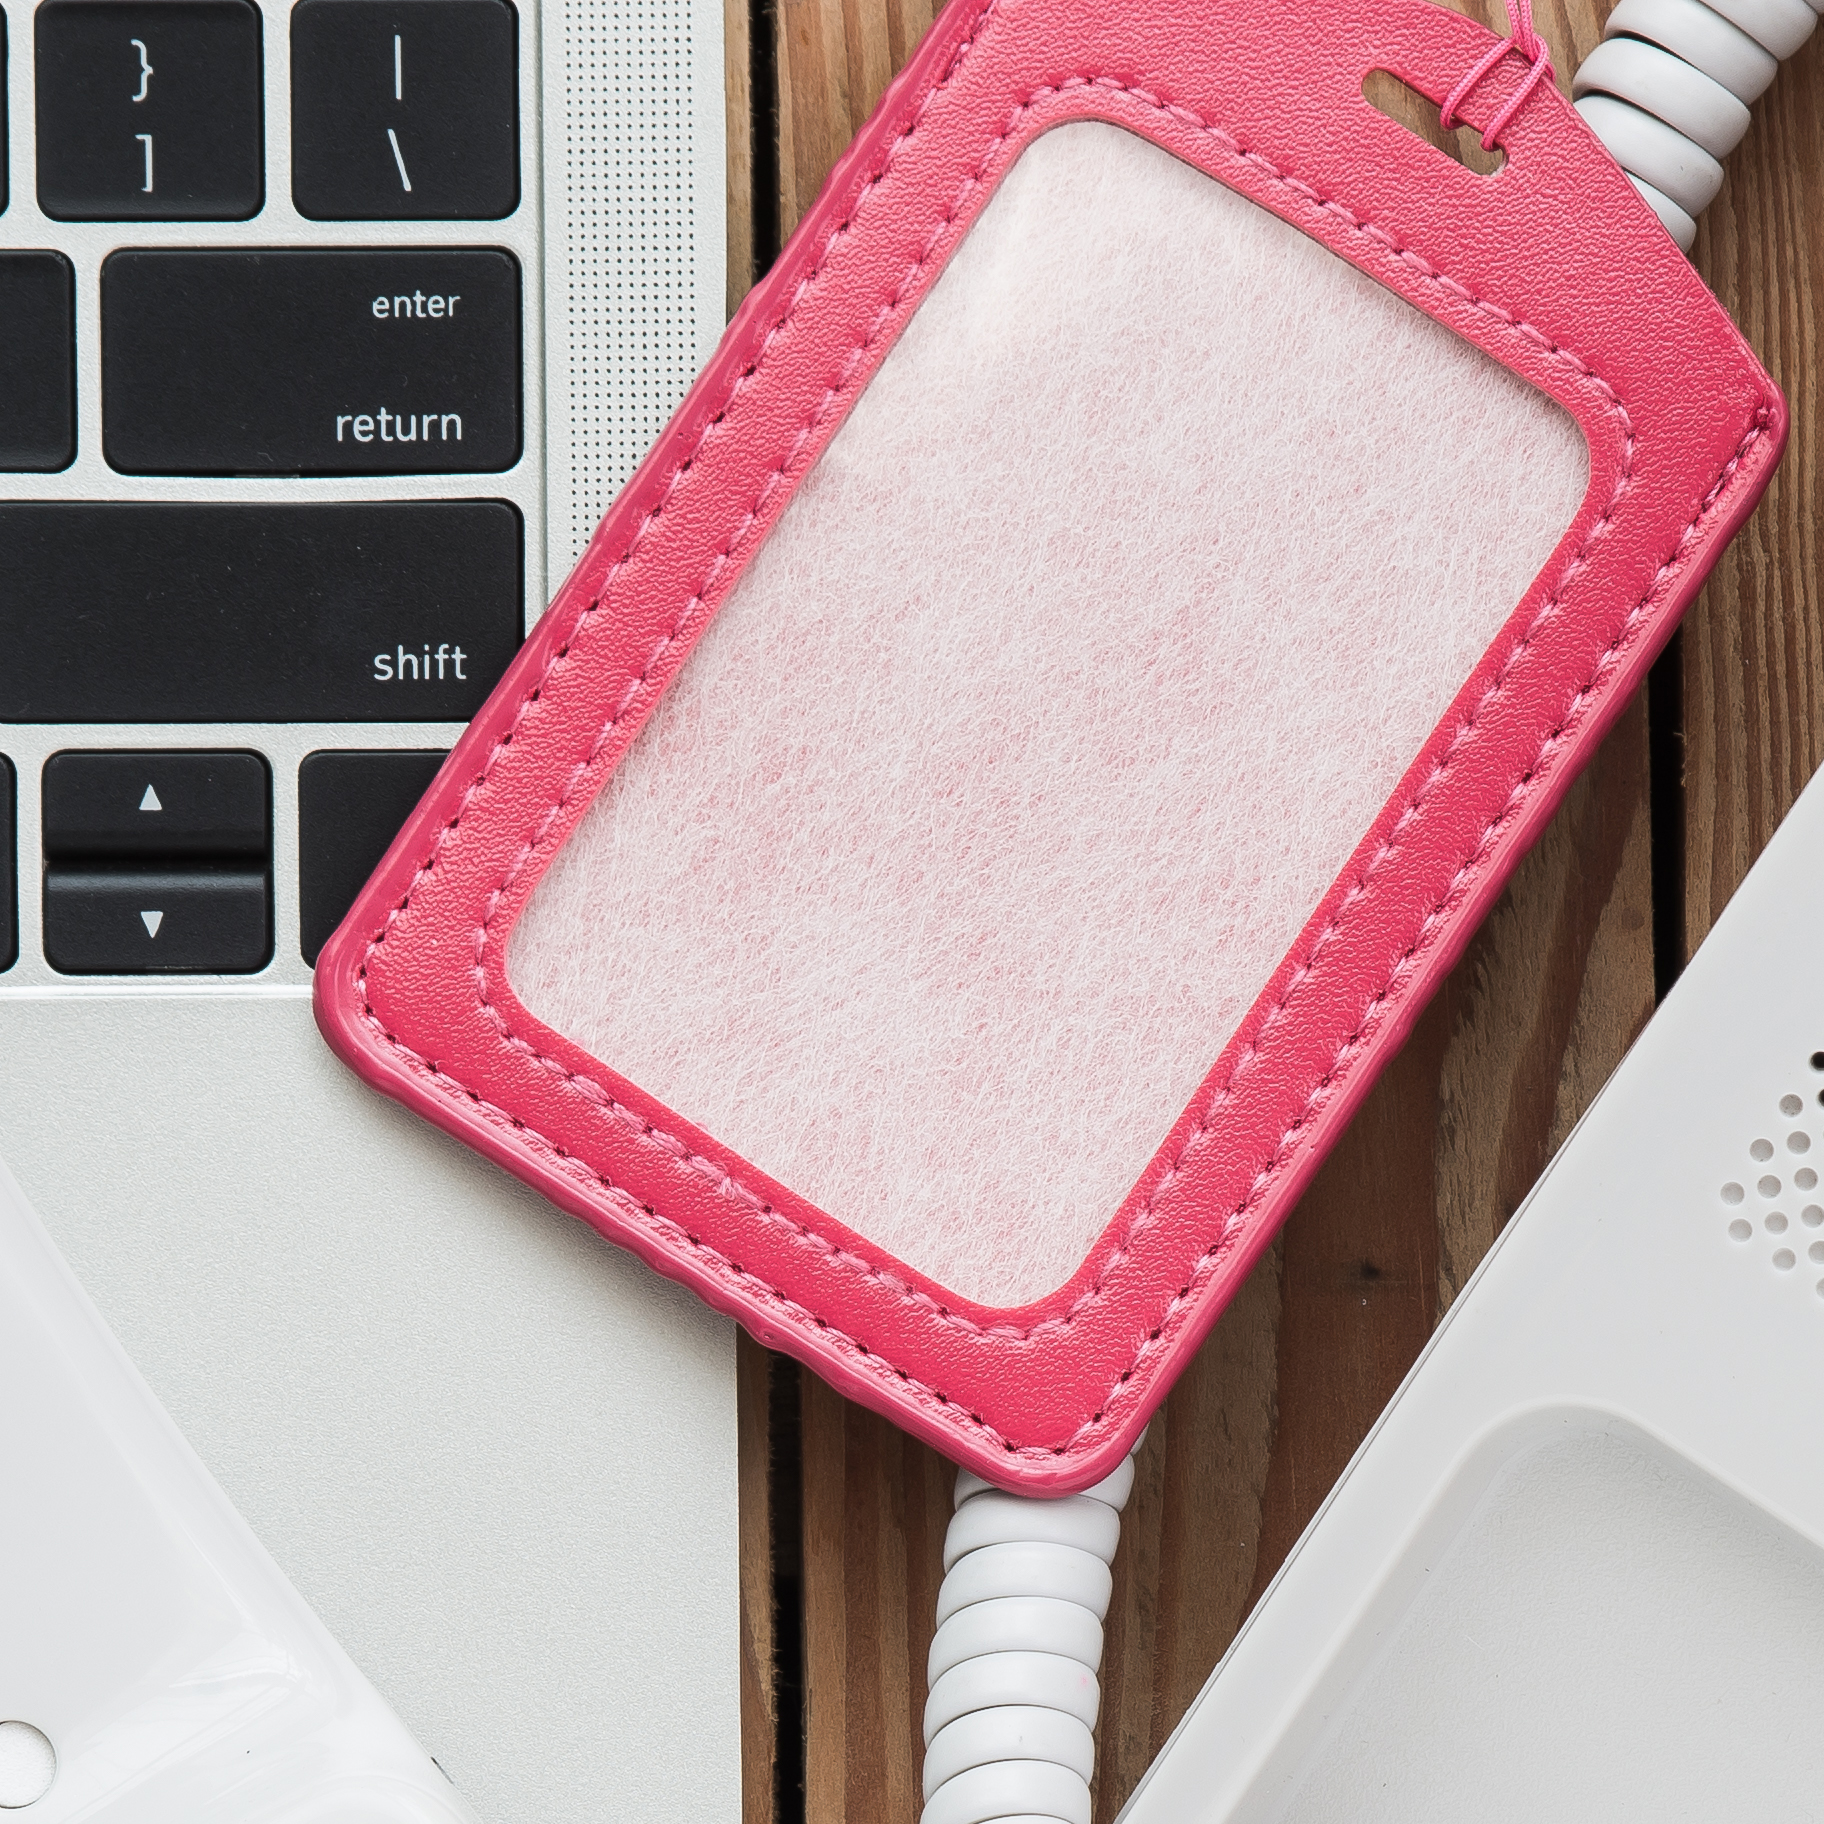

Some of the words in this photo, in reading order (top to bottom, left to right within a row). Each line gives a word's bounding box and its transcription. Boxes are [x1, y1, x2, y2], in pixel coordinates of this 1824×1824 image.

[131, 39, 154, 102] }
[135, 134, 154, 193] ]
[372, 290, 461, 319] enter
[336, 407, 462, 443] return
[373, 643, 467, 681] shift
